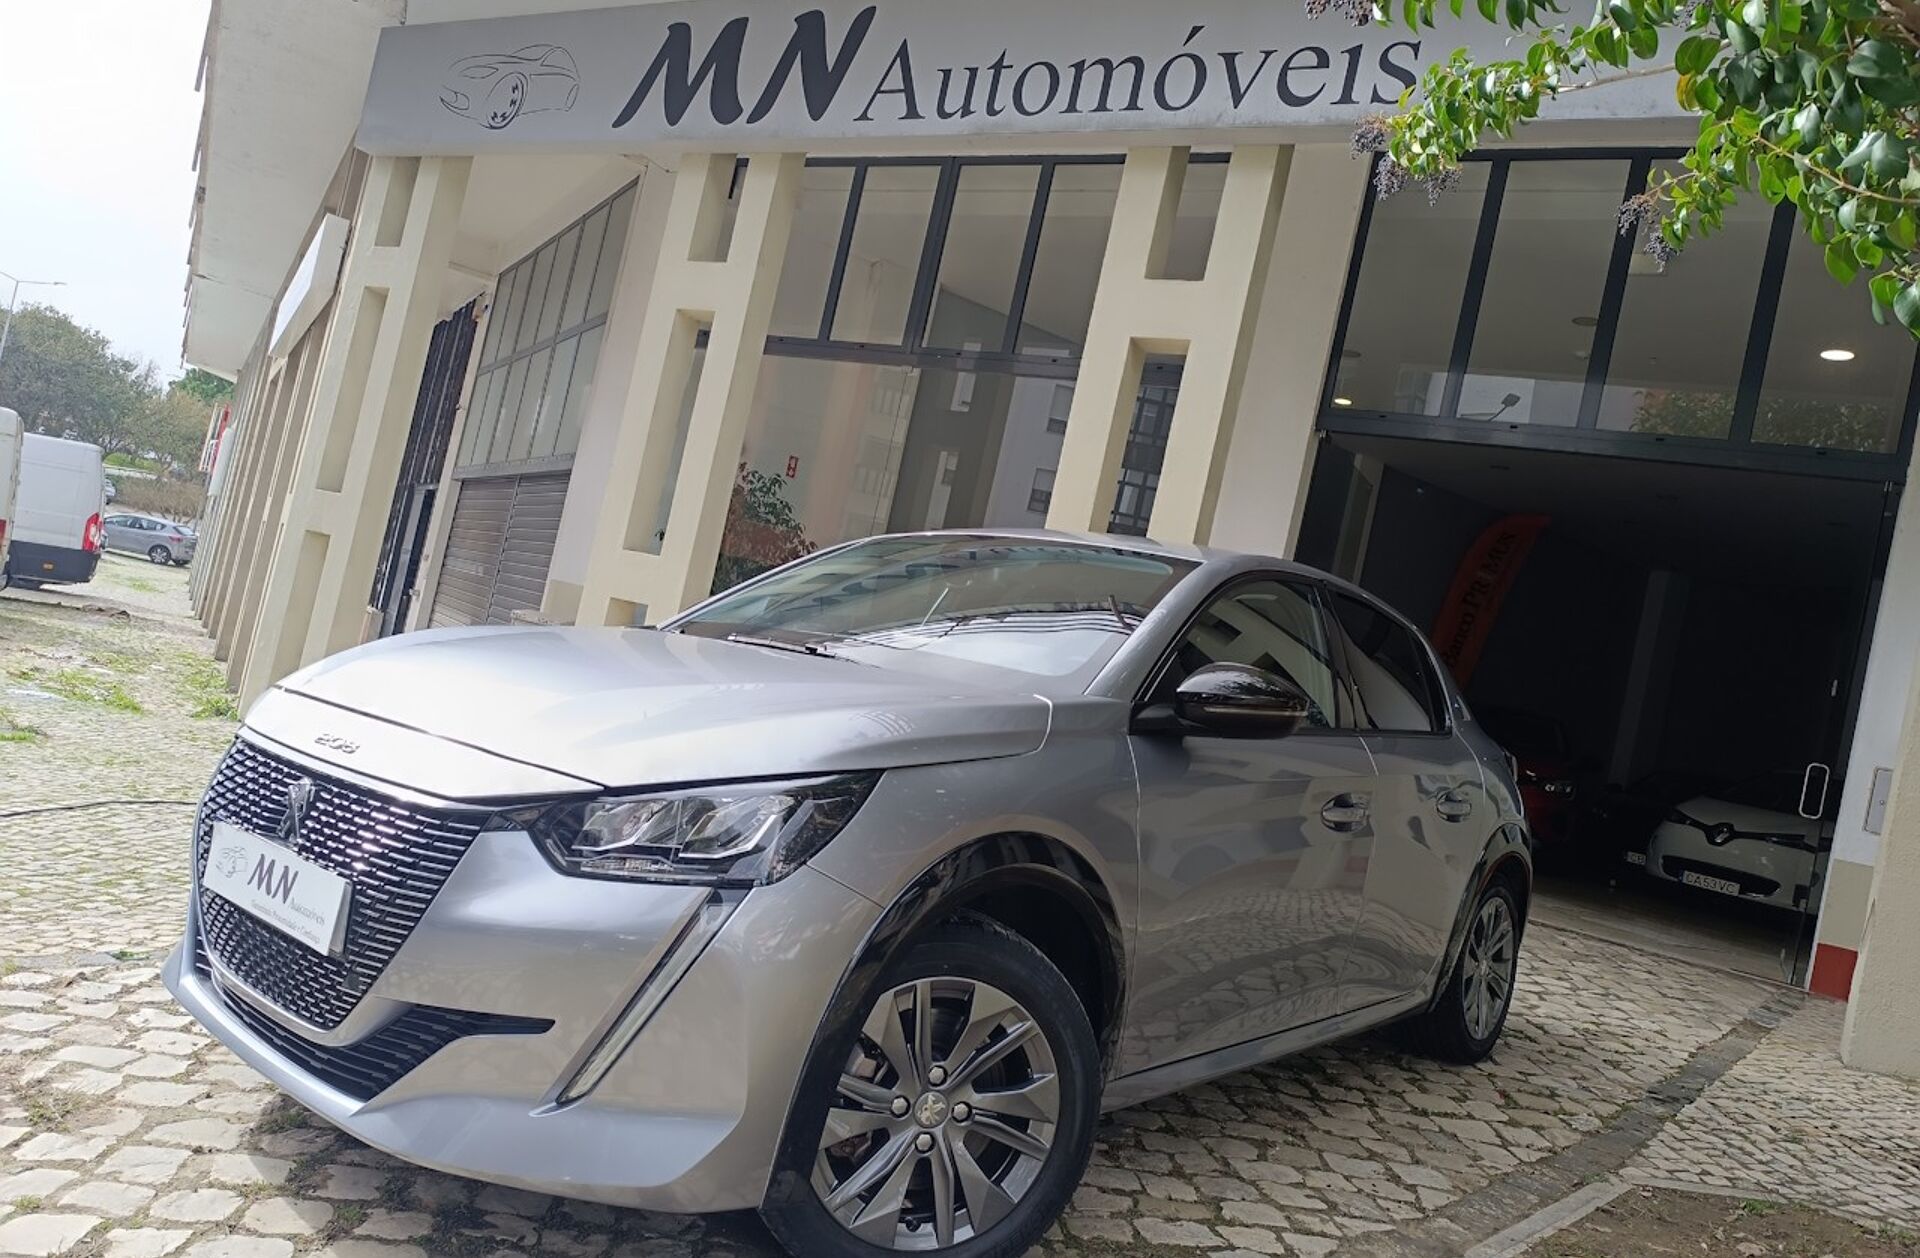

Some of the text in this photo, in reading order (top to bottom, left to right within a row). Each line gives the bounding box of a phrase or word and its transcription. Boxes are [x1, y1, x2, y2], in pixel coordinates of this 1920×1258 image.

[611, 6, 1422, 128] MN Automóveis
[314, 733, 361, 754] 208
[247, 853, 299, 904] MN
